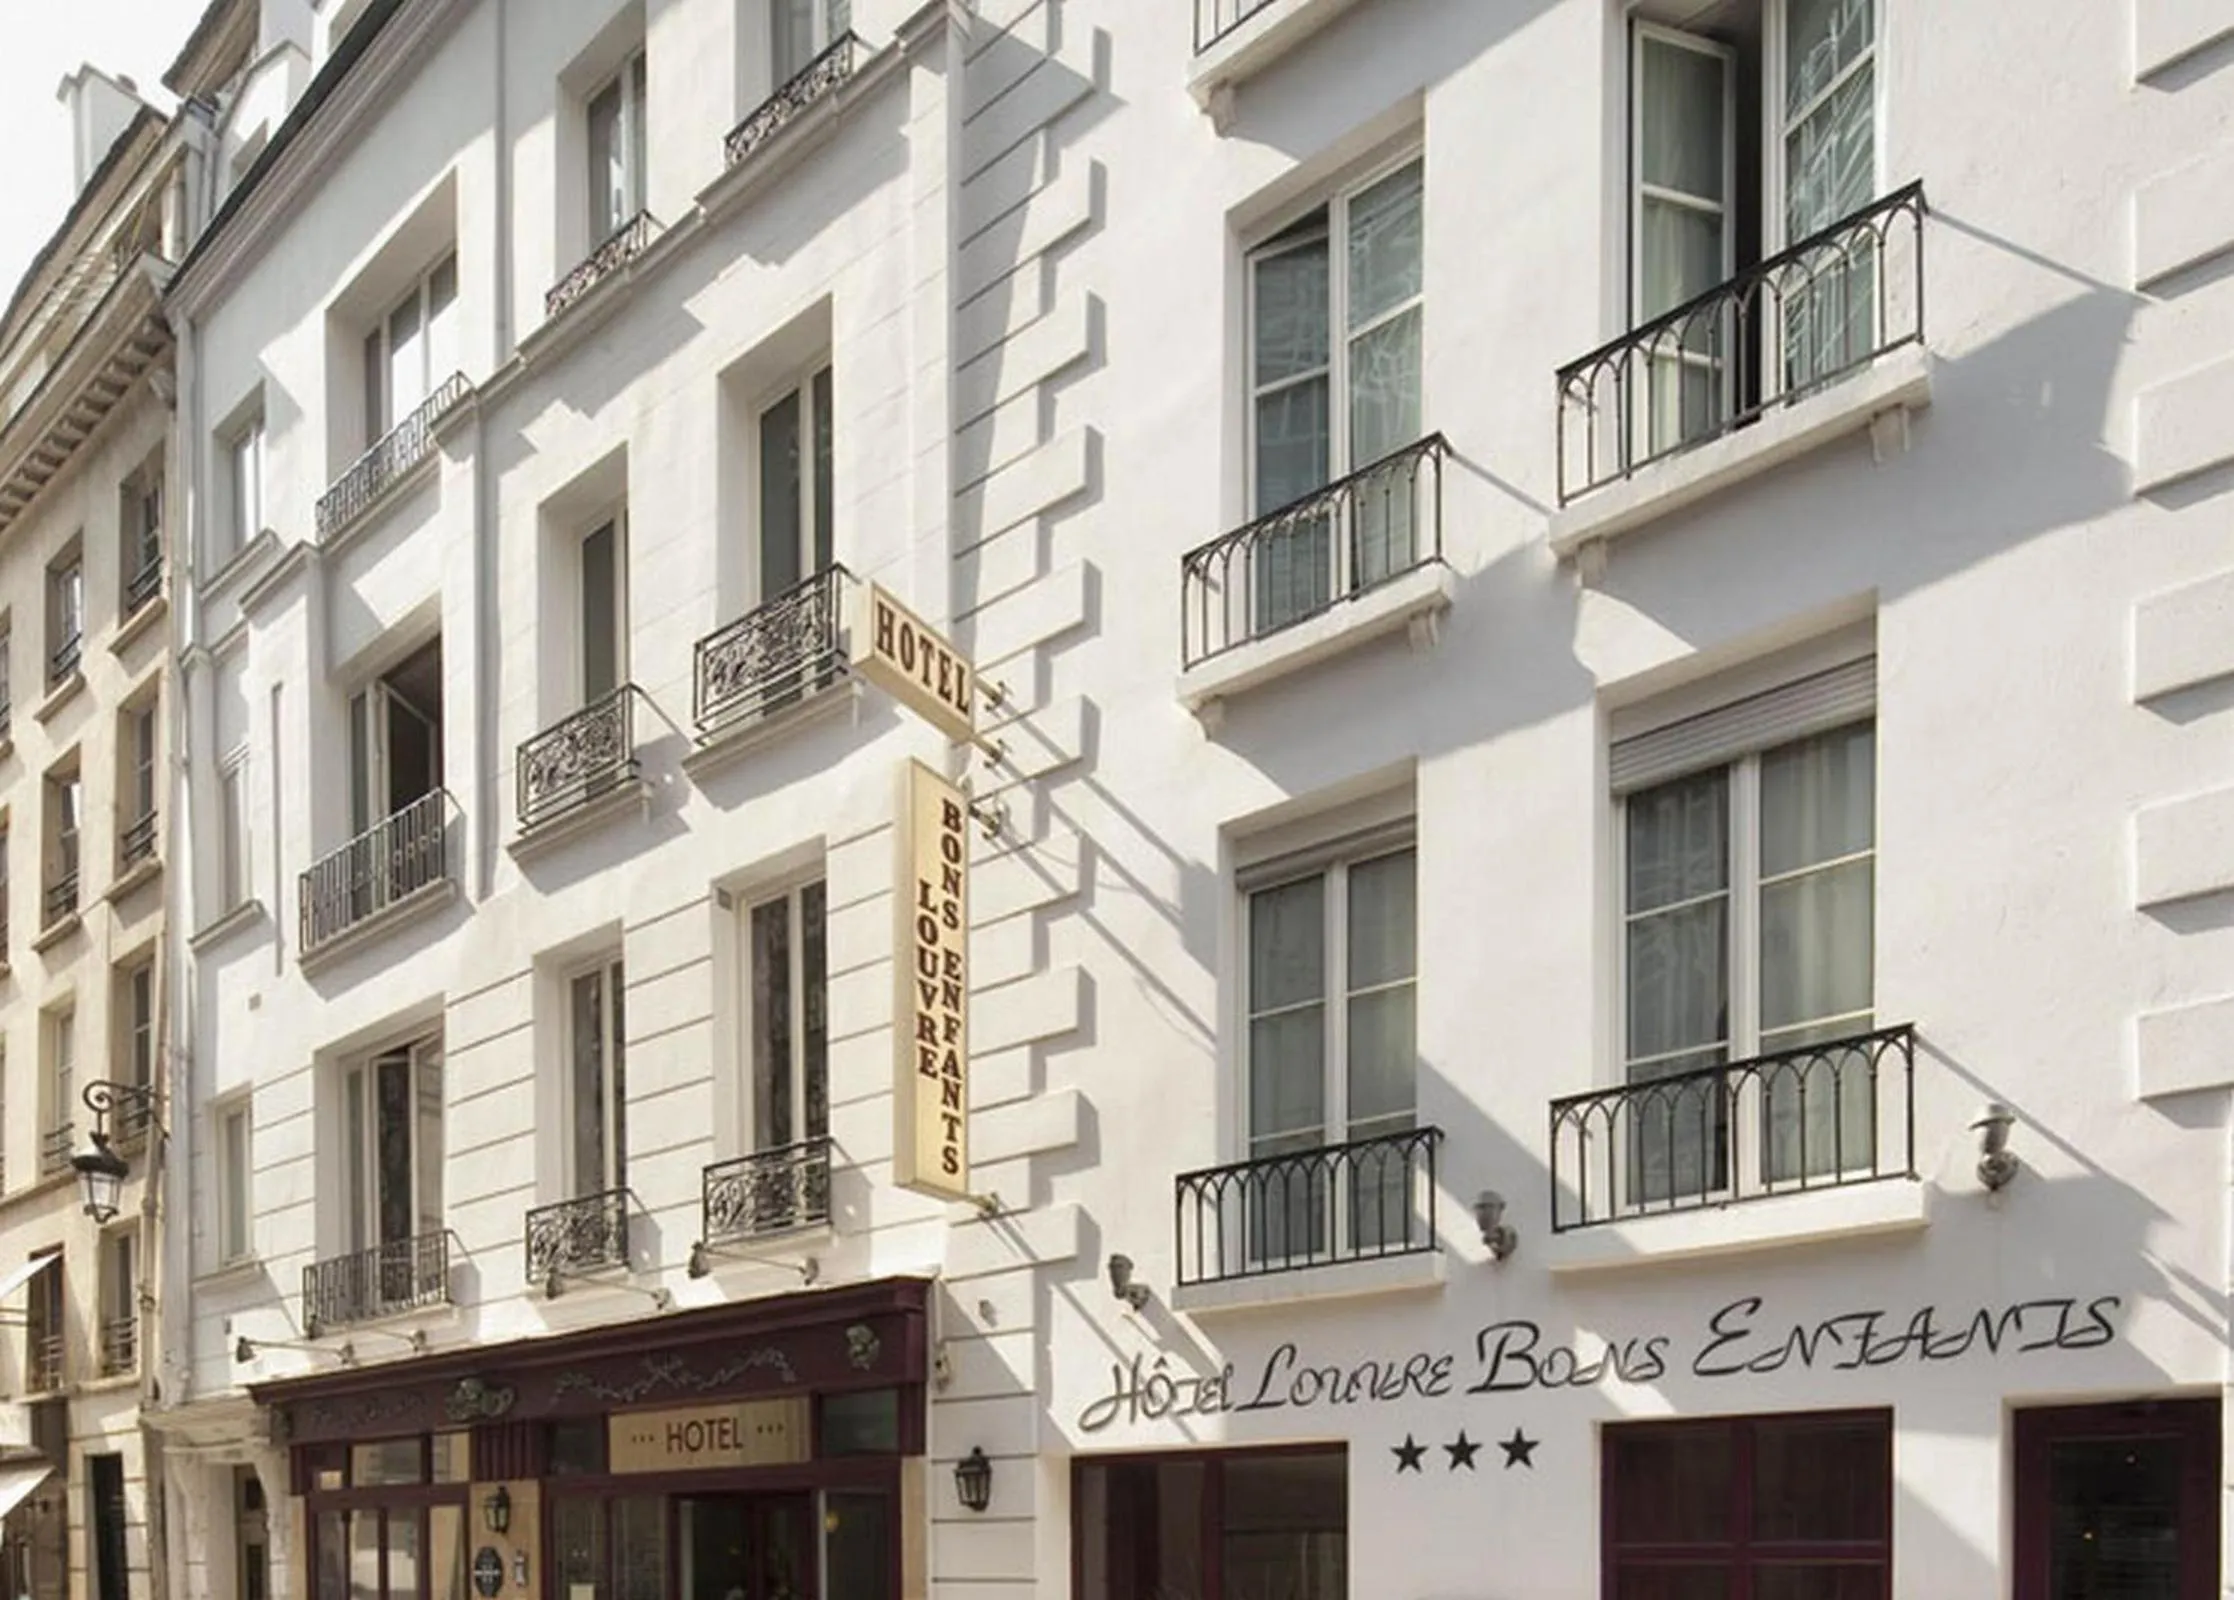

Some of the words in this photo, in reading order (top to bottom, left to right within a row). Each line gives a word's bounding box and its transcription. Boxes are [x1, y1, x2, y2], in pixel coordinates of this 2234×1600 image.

[877, 600, 969, 716] HOTEL
[941, 798, 962, 931] BONS
[916, 878, 939, 1080] LOUVRE
[941, 948, 962, 1176] ENFANTS
[665, 1417, 744, 1454] HOTEL
